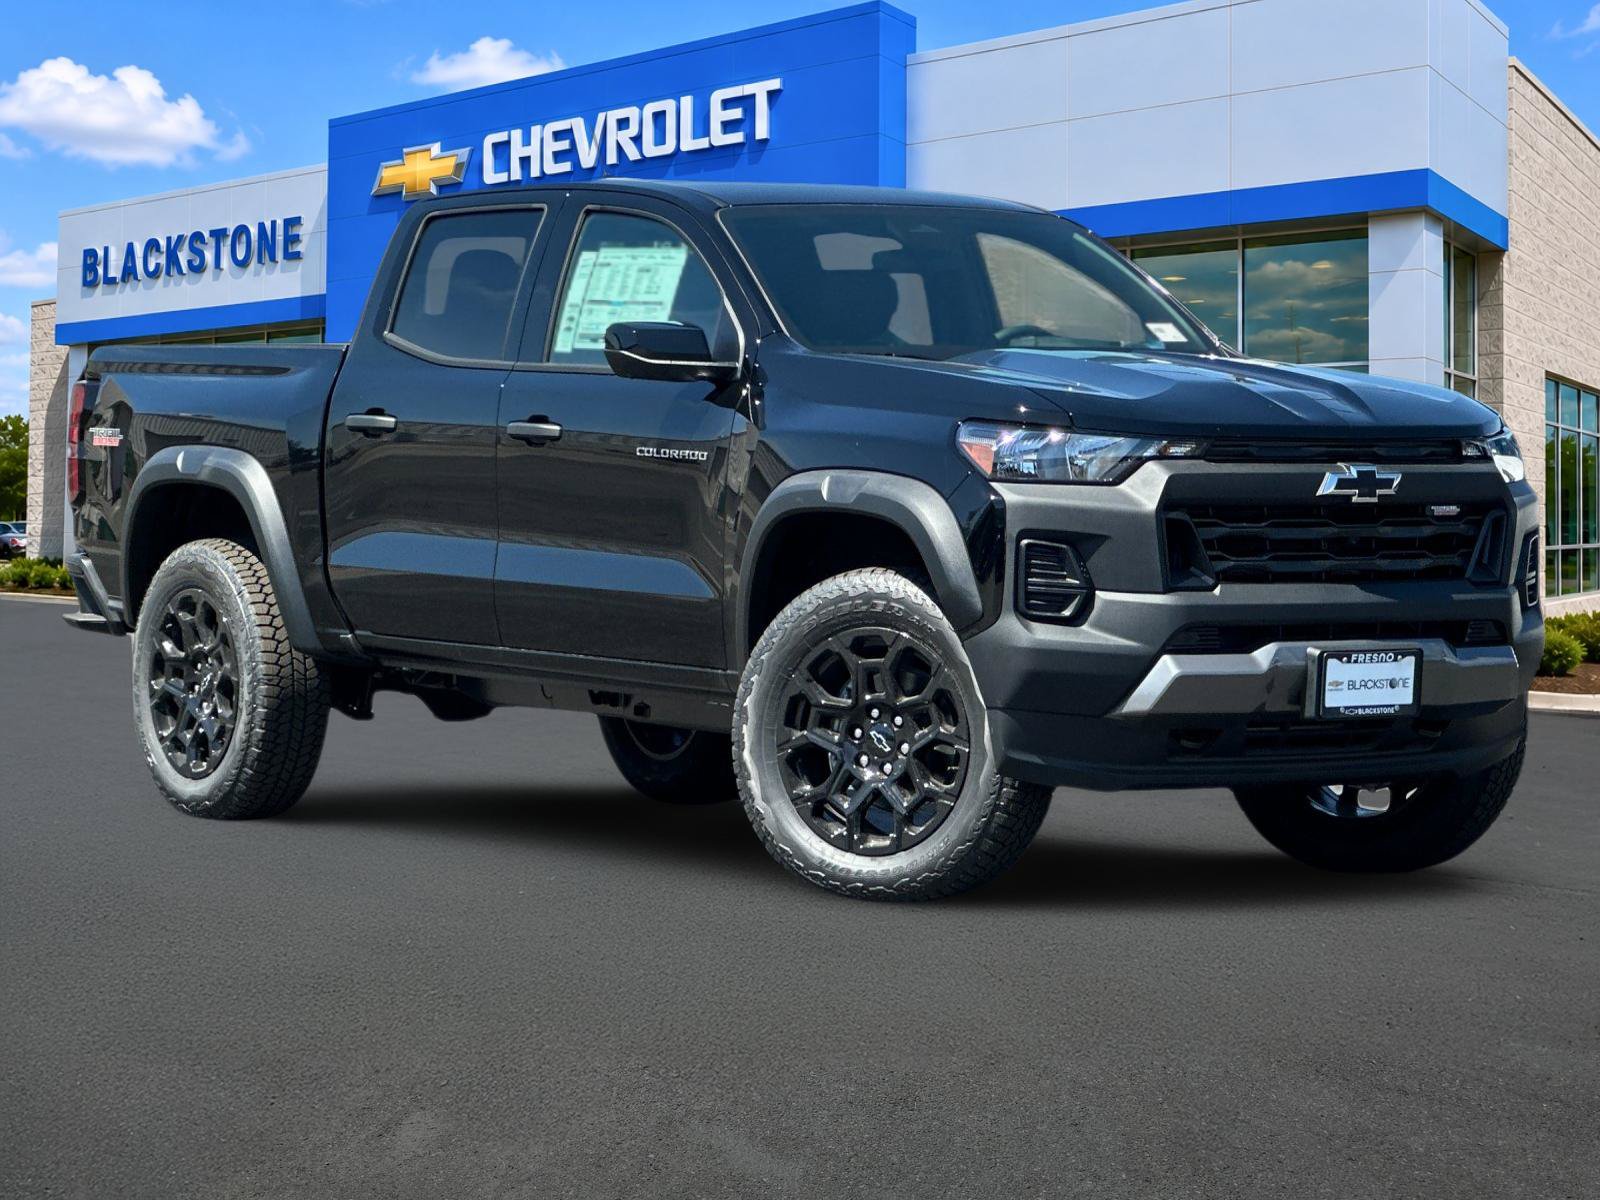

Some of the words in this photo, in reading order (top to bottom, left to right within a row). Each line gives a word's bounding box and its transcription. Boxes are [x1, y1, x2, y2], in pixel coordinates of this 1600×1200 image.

[483, 78, 783, 184] CHEVROLET
[82, 216, 302, 287] BLACKSTONE
[636, 447, 708, 460] COLORADO
[1351, 653, 1394, 663] FRESNO
[1347, 678, 1410, 690] BLACKSTONE
